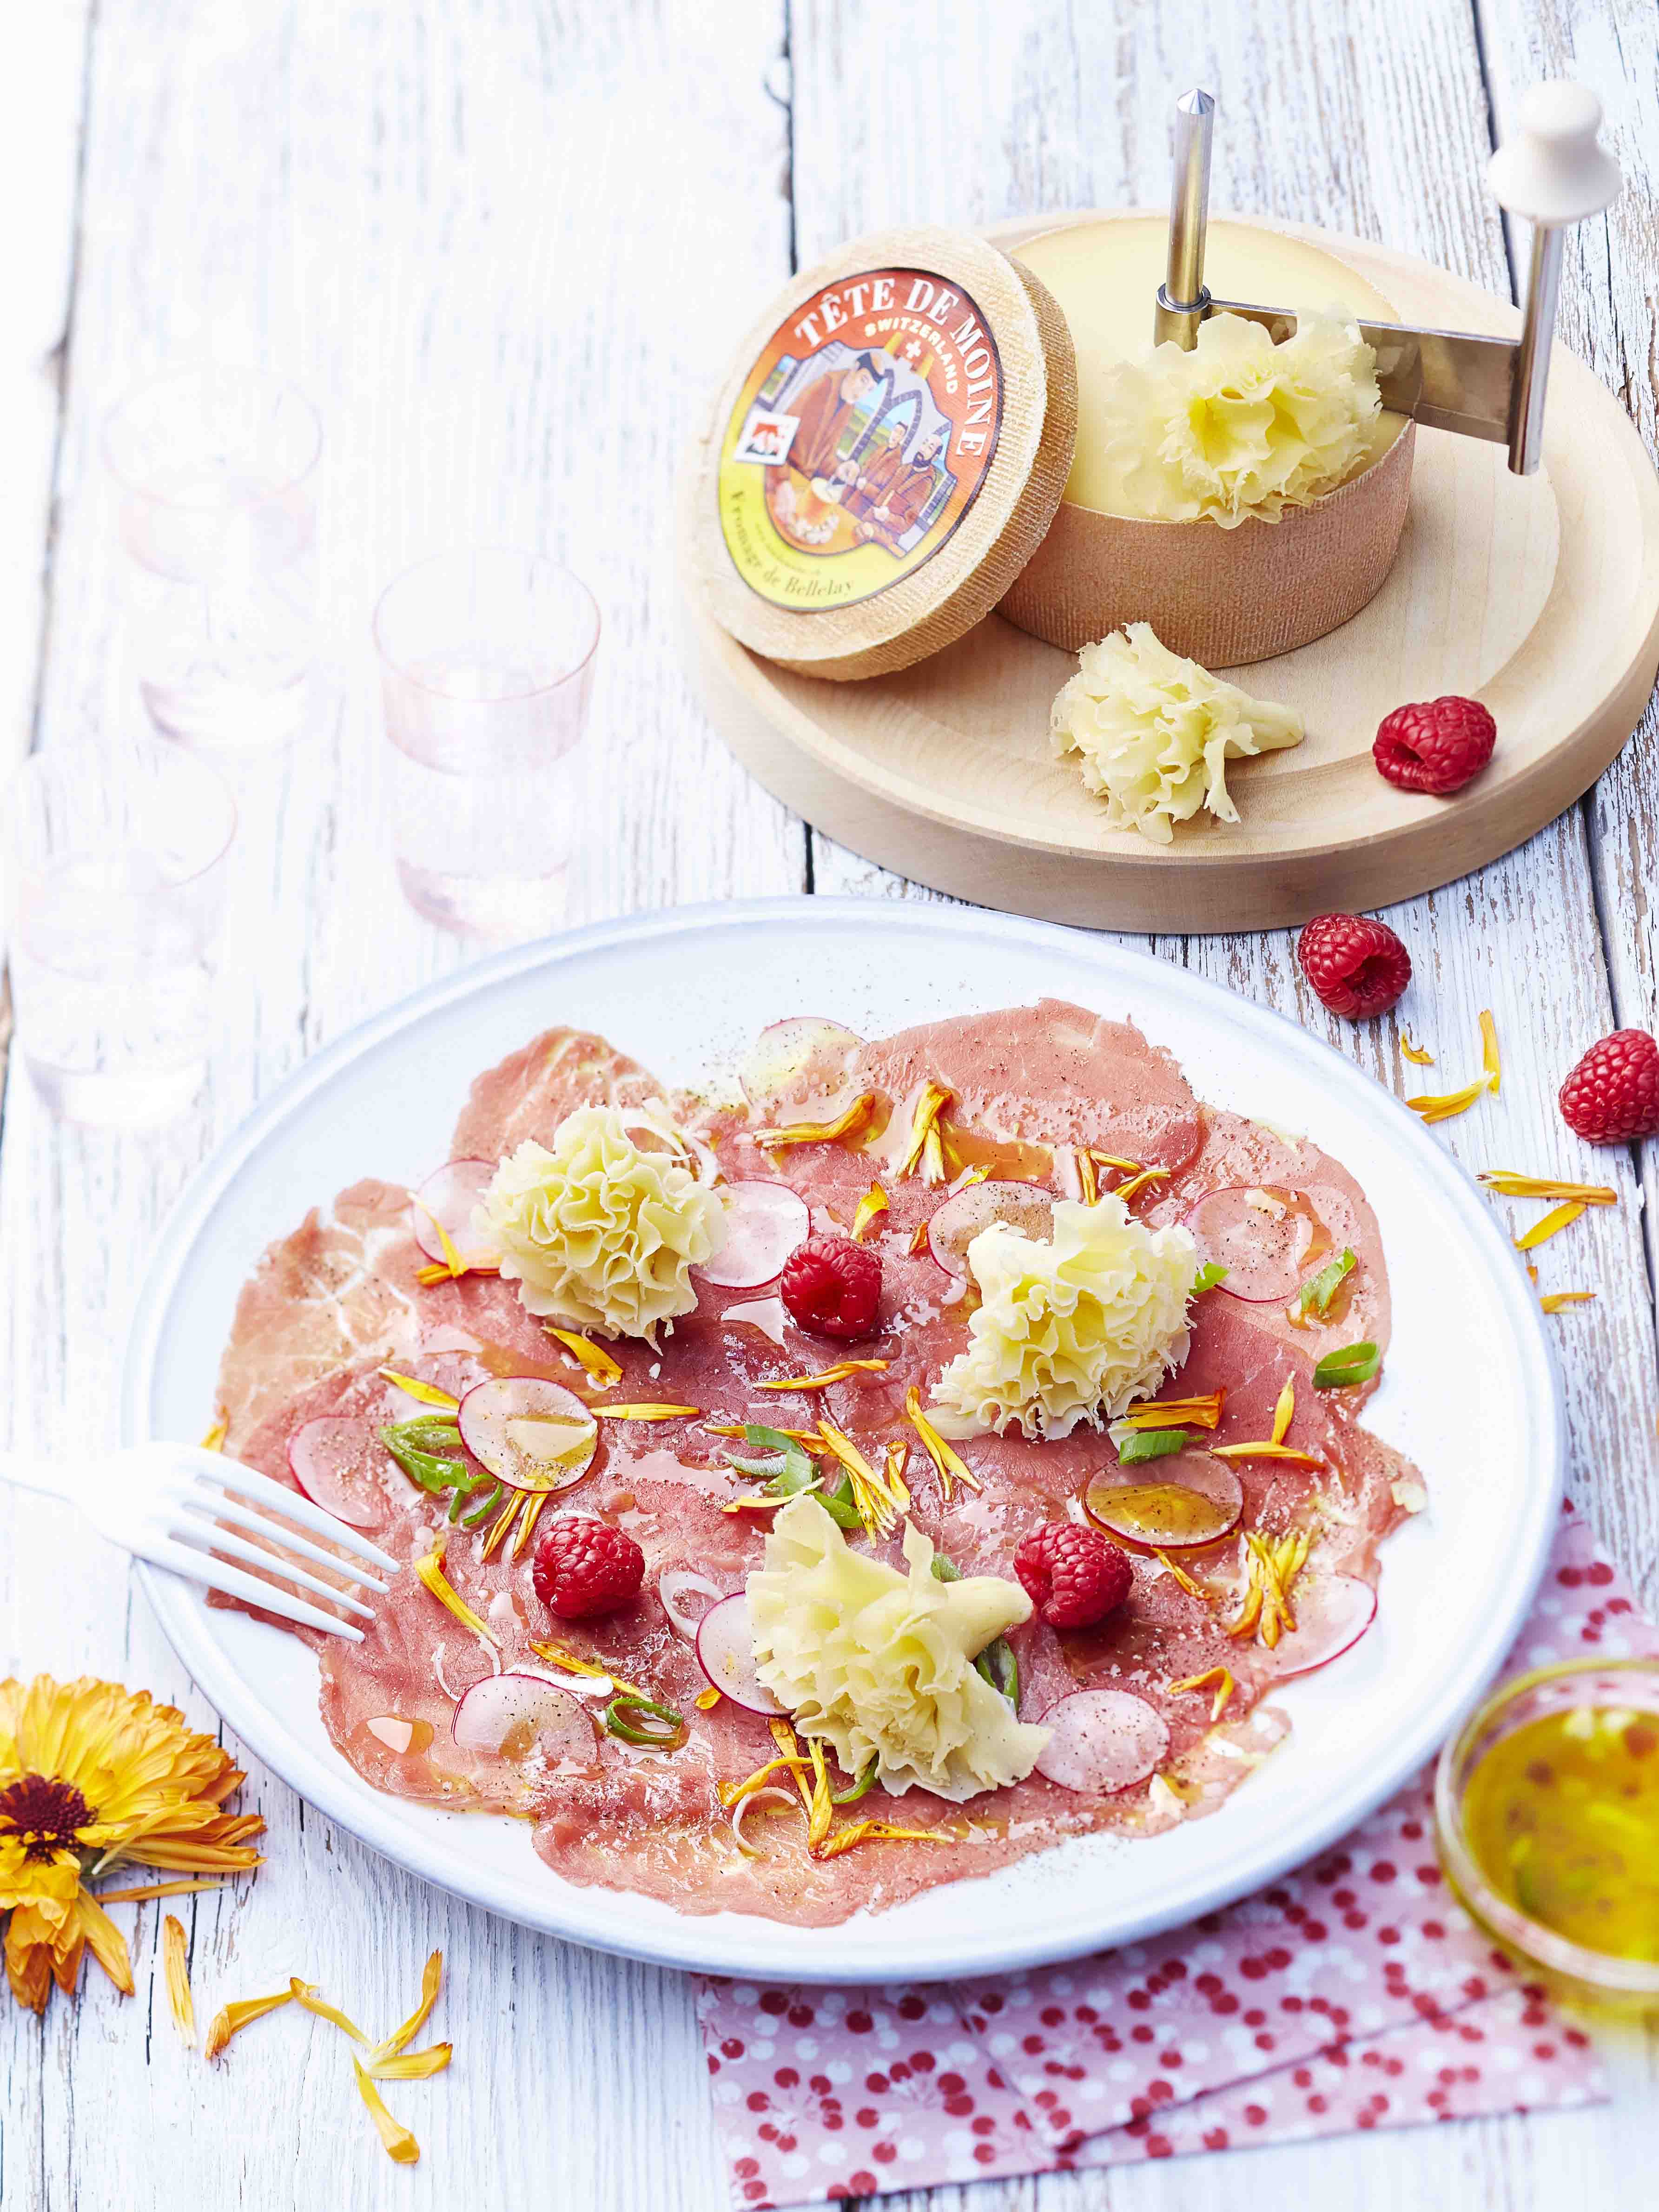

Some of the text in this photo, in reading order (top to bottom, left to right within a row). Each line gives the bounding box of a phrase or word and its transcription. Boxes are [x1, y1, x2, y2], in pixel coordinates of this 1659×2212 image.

[794, 278, 993, 456] TÊTE DE MOINE
[864, 317, 958, 394] SWITZERLAND
[763, 564, 781, 586] de
[784, 576, 855, 597] Bellelay
